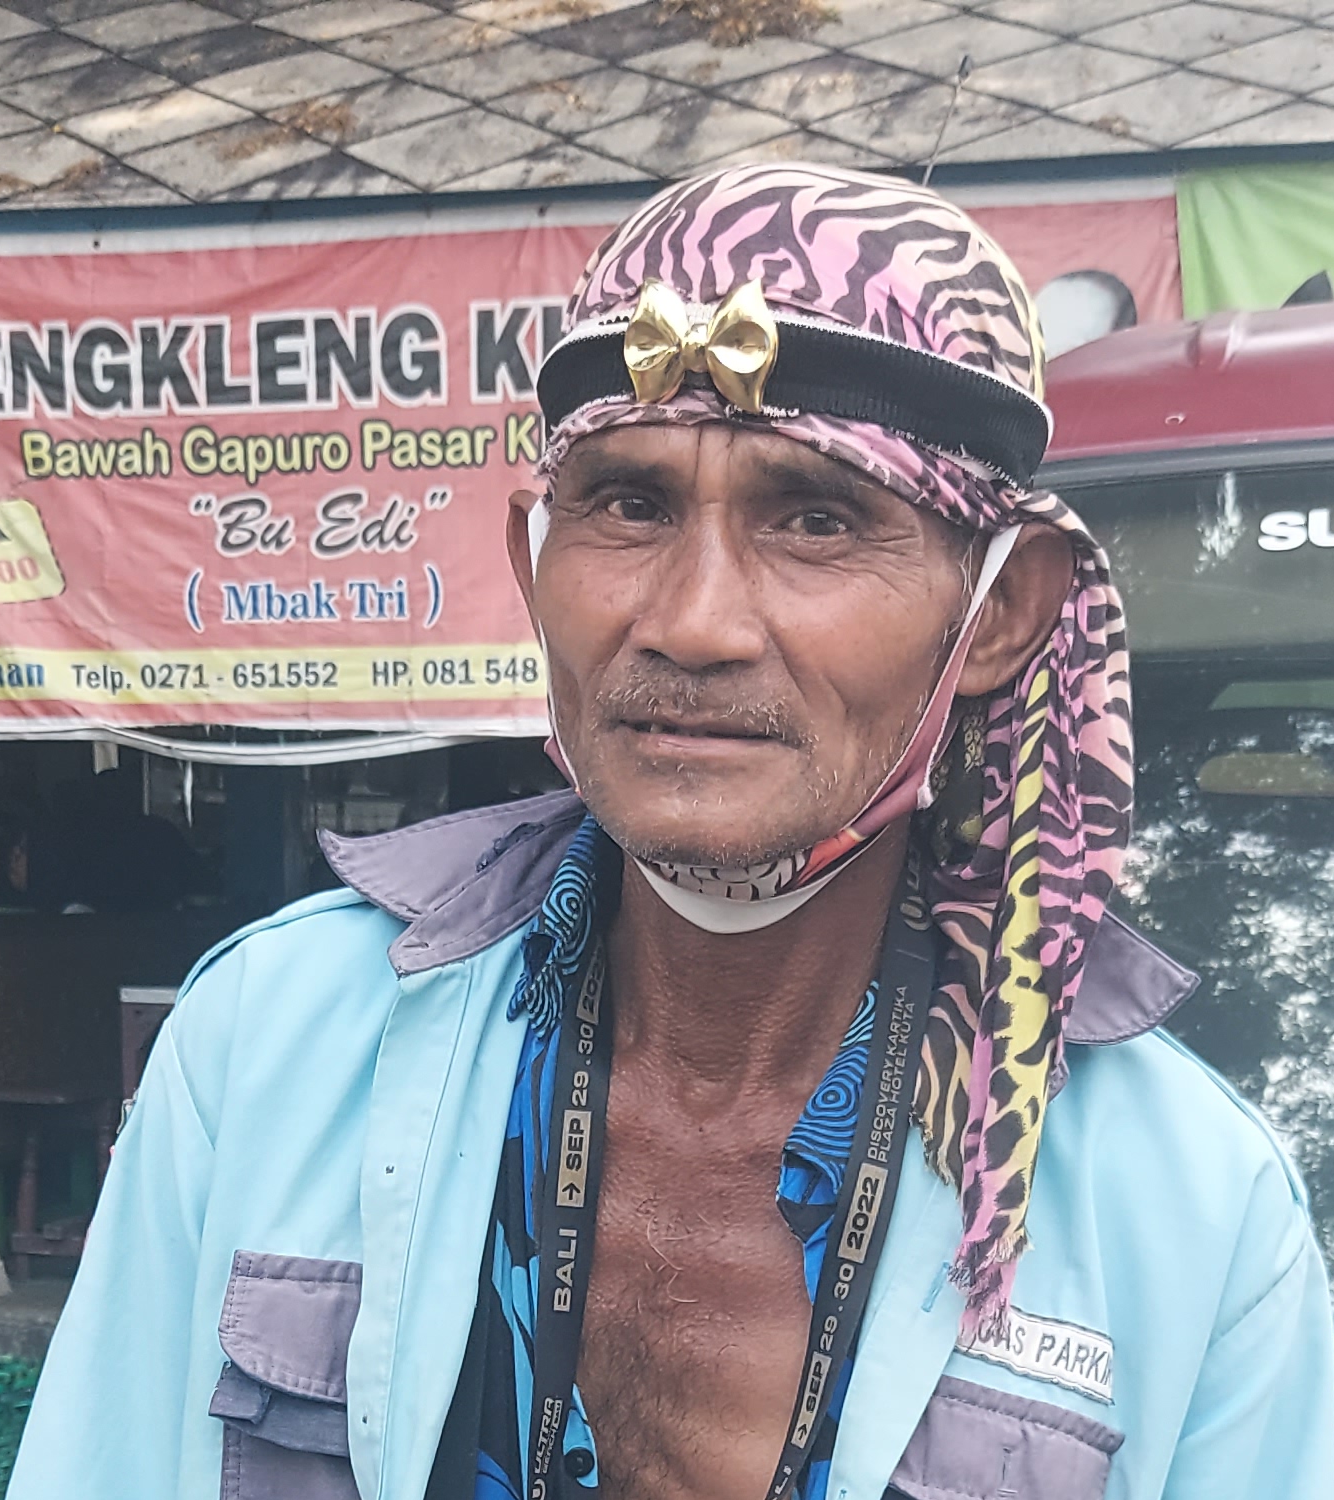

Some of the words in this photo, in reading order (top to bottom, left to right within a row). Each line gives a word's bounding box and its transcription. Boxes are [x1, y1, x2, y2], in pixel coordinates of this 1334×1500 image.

[21, 430, 171, 476] Bawah
[183, 426, 349, 484] Gapuro
[360, 421, 496, 470] Pasar
[505, 414, 543, 466] K
[193, 497, 293, 551] "Bu
[314, 491, 448, 556] Edi"
[222, 581, 337, 621] Mbak
[348, 579, 408, 619] Tri
[72, 664, 132, 695] Telp.
[140, 663, 210, 690] 0271
[232, 661, 339, 689] 651552
[422, 659, 475, 686] 081
[483, 656, 539, 685] 548
[898, 1002, 916, 1045] KUTA
[867, 1059, 893, 1160] DISCOVERY
[885, 985, 908, 1056] KARTIKA
[891, 1046, 908, 1104] HOTEL
[877, 1106, 898, 1164] PLAZA
[554, 1228, 578, 1313] BALI
[567, 1117, 585, 1172] SEP
[805, 1360, 825, 1414] SEP
[846, 1175, 881, 1251] 2022
[1034, 1332, 1111, 1386] PARKI
[534, 1397, 556, 1475] ULTRA
